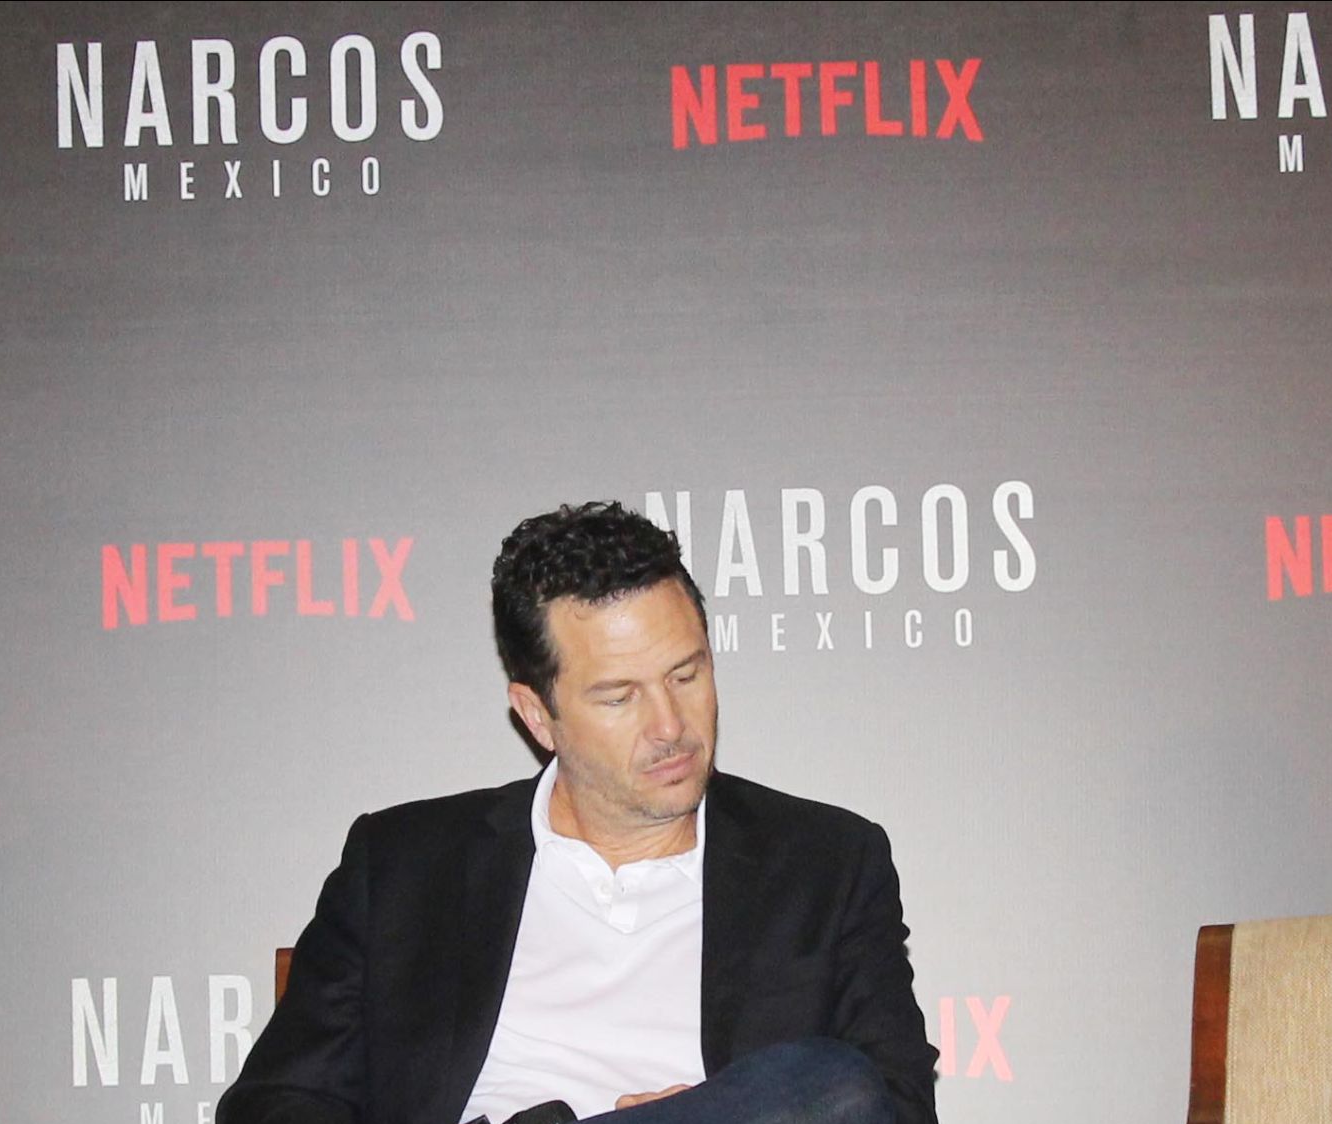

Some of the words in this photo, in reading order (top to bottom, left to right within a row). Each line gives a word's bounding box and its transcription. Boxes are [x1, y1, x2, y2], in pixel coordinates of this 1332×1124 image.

[57, 32, 443, 148] NARCOS
[670, 57, 984, 150] NETFLIX
[124, 157, 380, 201] MEXICO
[100, 537, 414, 631] NETFLIX
[714, 609, 973, 653] MEXICO
